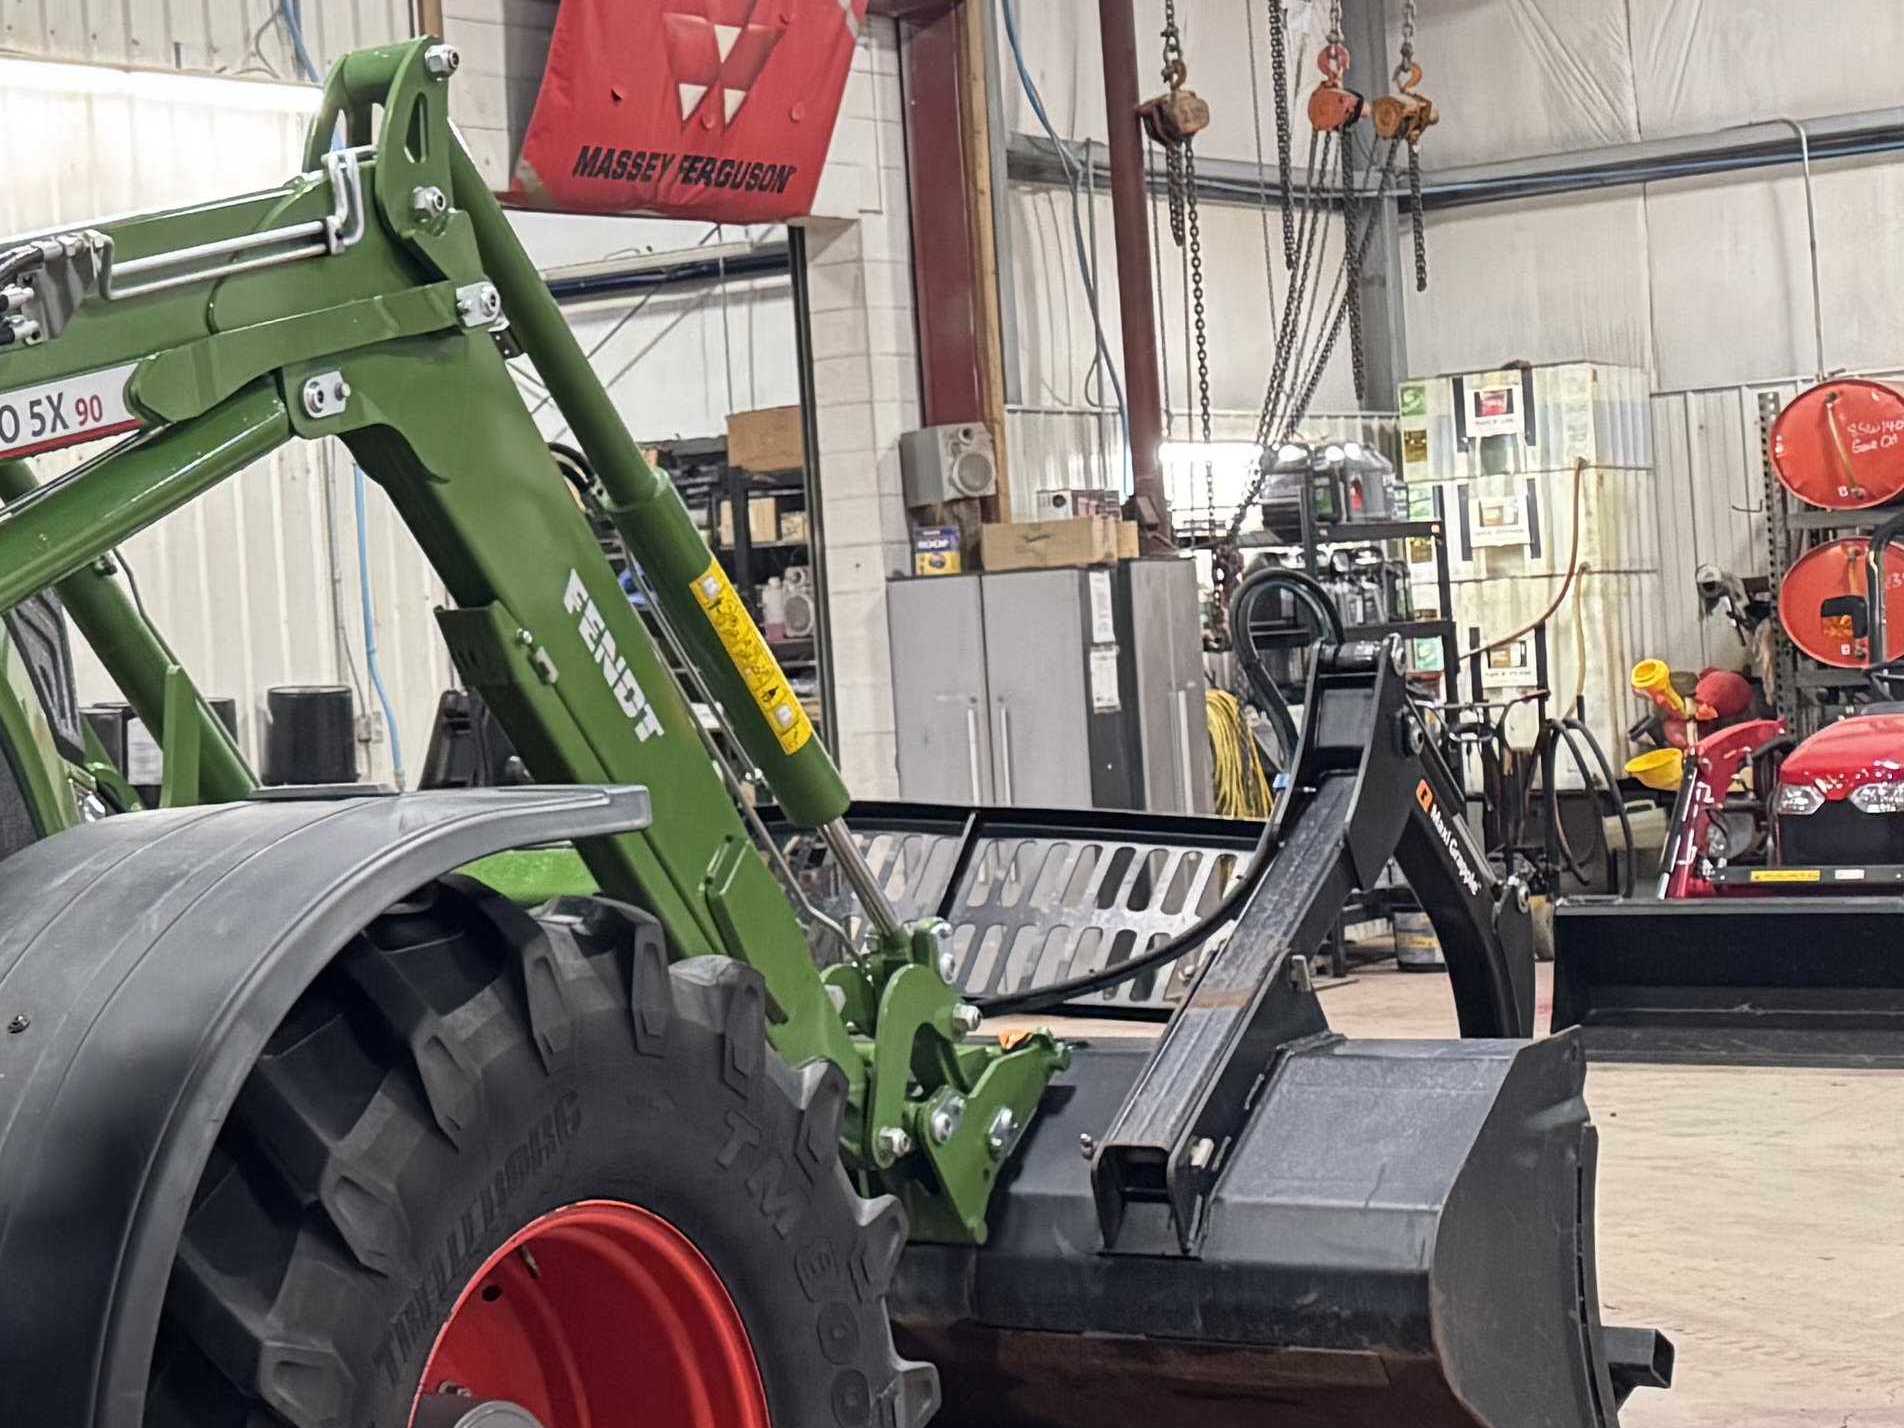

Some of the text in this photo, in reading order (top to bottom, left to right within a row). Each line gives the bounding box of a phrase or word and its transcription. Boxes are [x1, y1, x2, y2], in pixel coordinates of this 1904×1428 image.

[572, 145, 797, 194] MASSEY FERGUSON
[30, 392, 70, 438] 5X
[75, 394, 104, 426] 90
[563, 568, 665, 743] FENDT
[1430, 803, 1452, 847] Maxi
[372, 1089, 584, 1387] TRELLEBORG
